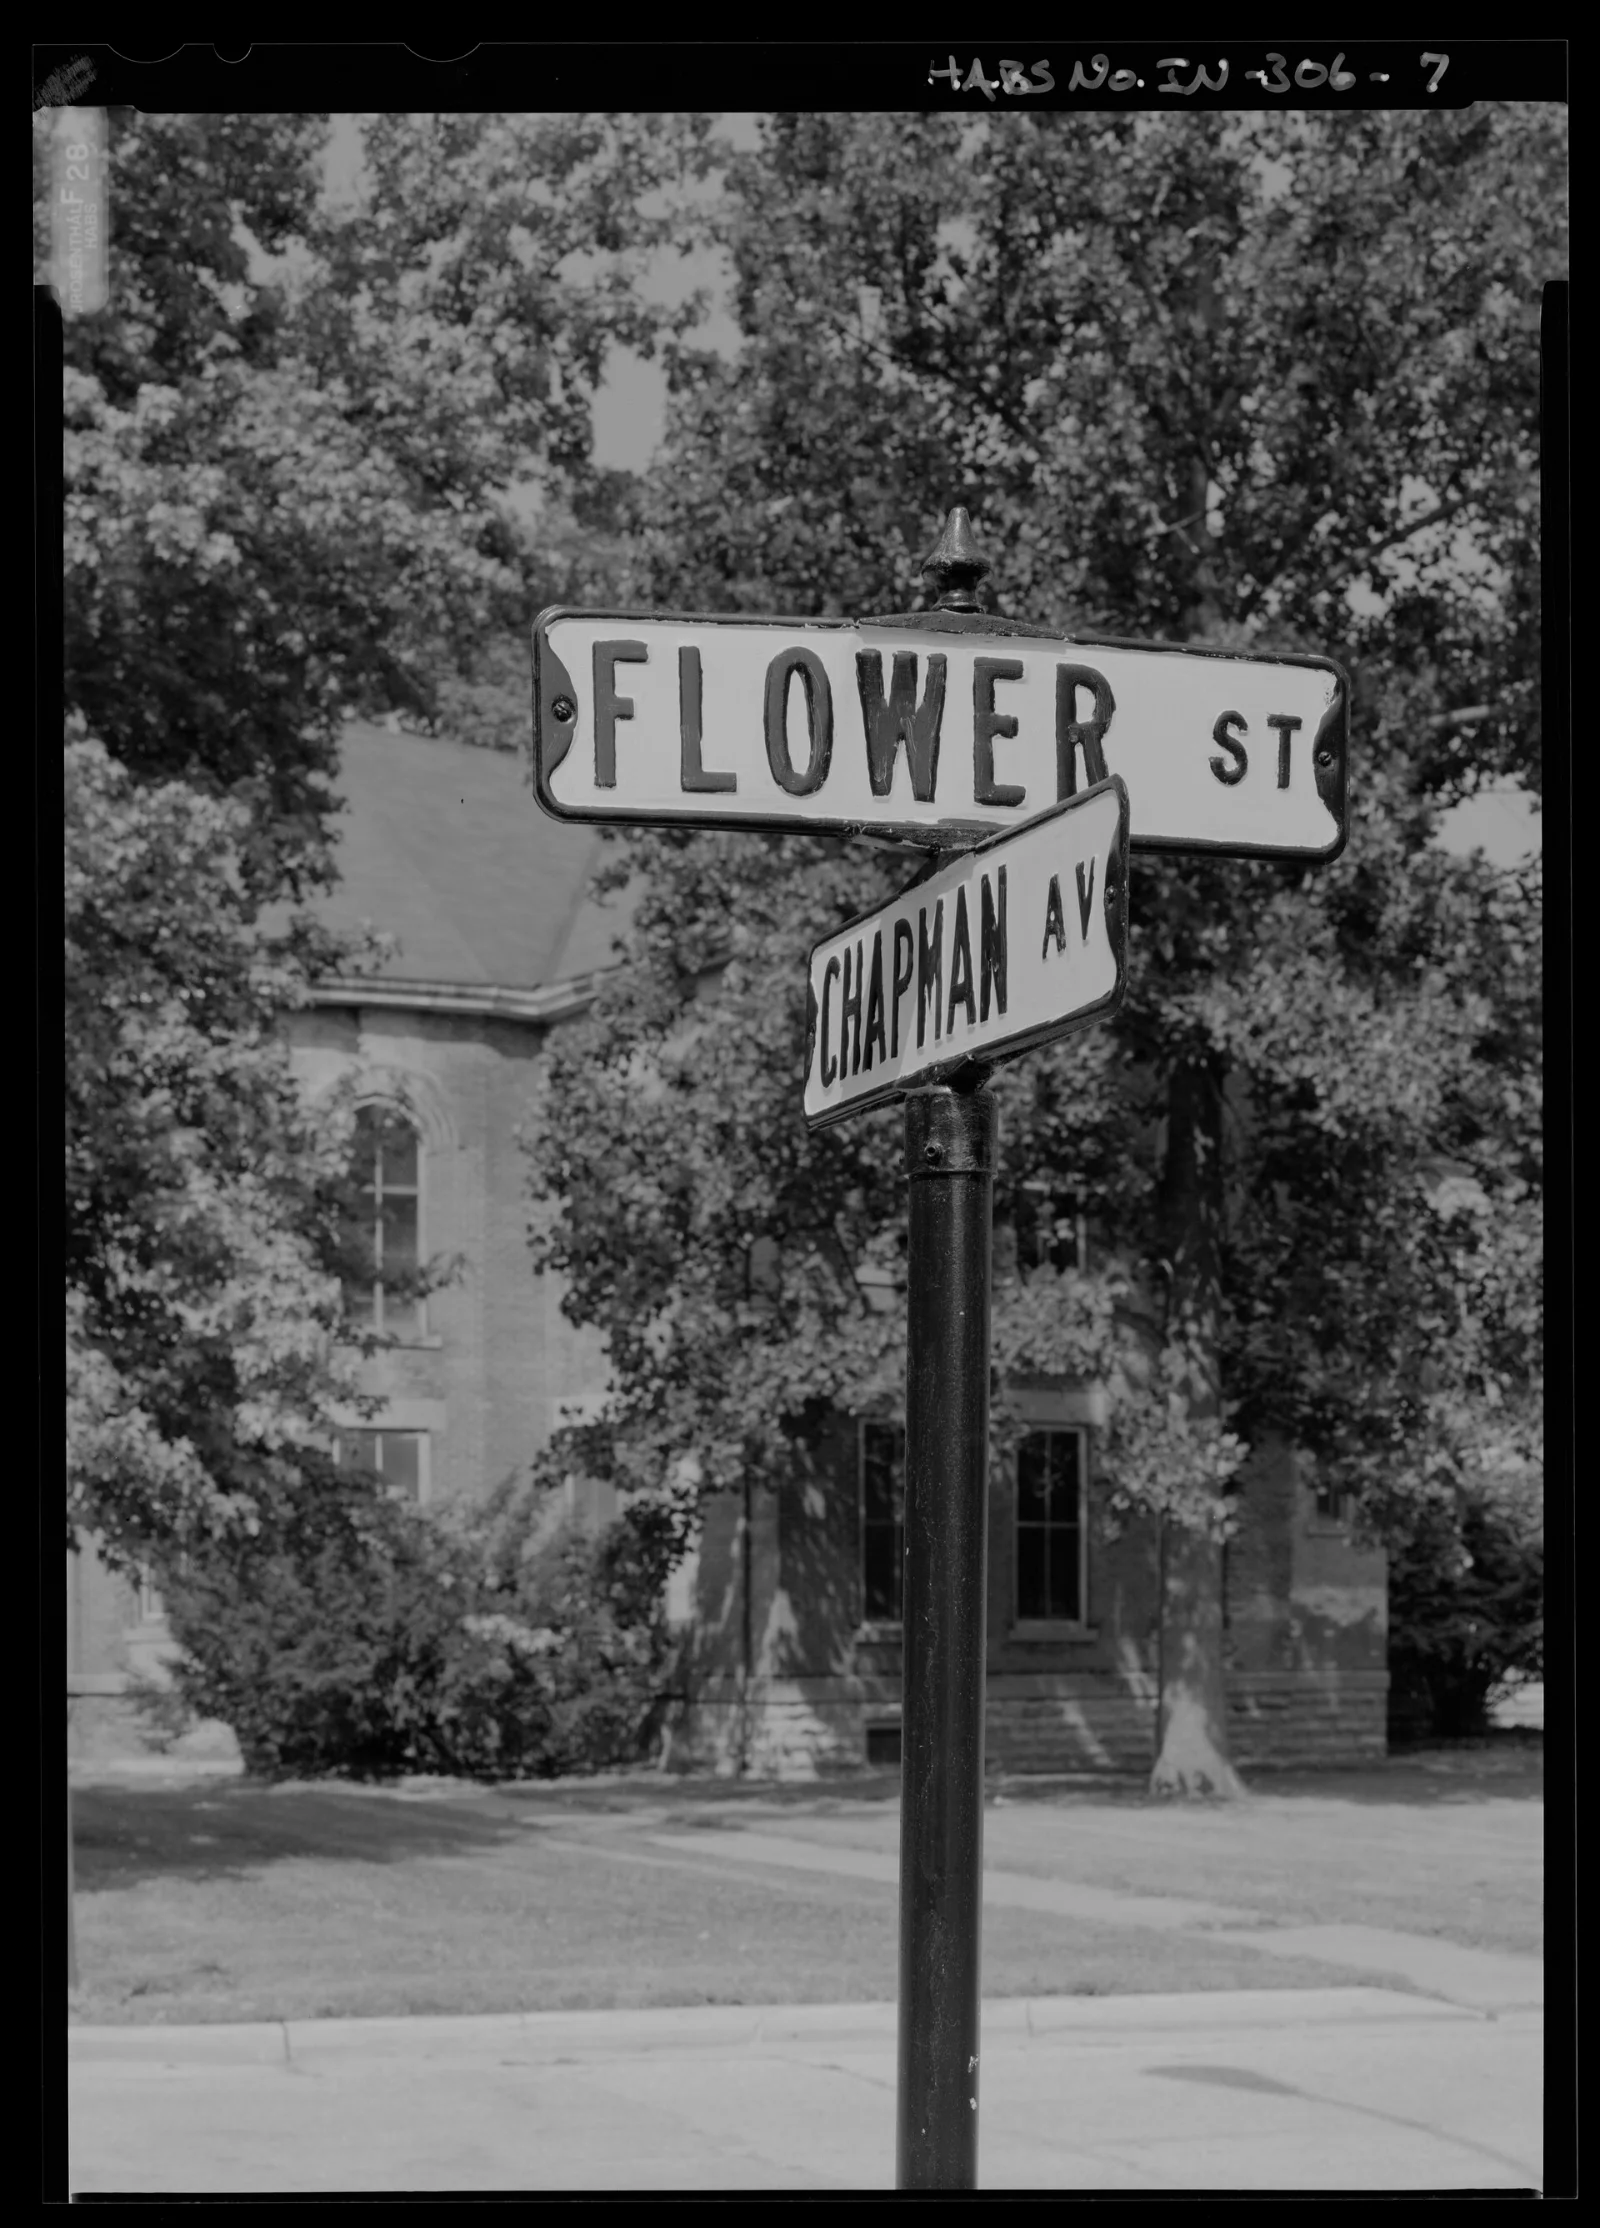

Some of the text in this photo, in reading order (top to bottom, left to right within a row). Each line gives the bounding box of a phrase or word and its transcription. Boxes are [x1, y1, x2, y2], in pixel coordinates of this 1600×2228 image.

[928, 55, 1055, 101] HABS
[592, 640, 1302, 803] FLOWER ST
[820, 856, 1095, 1089] CHAPMAN AV
